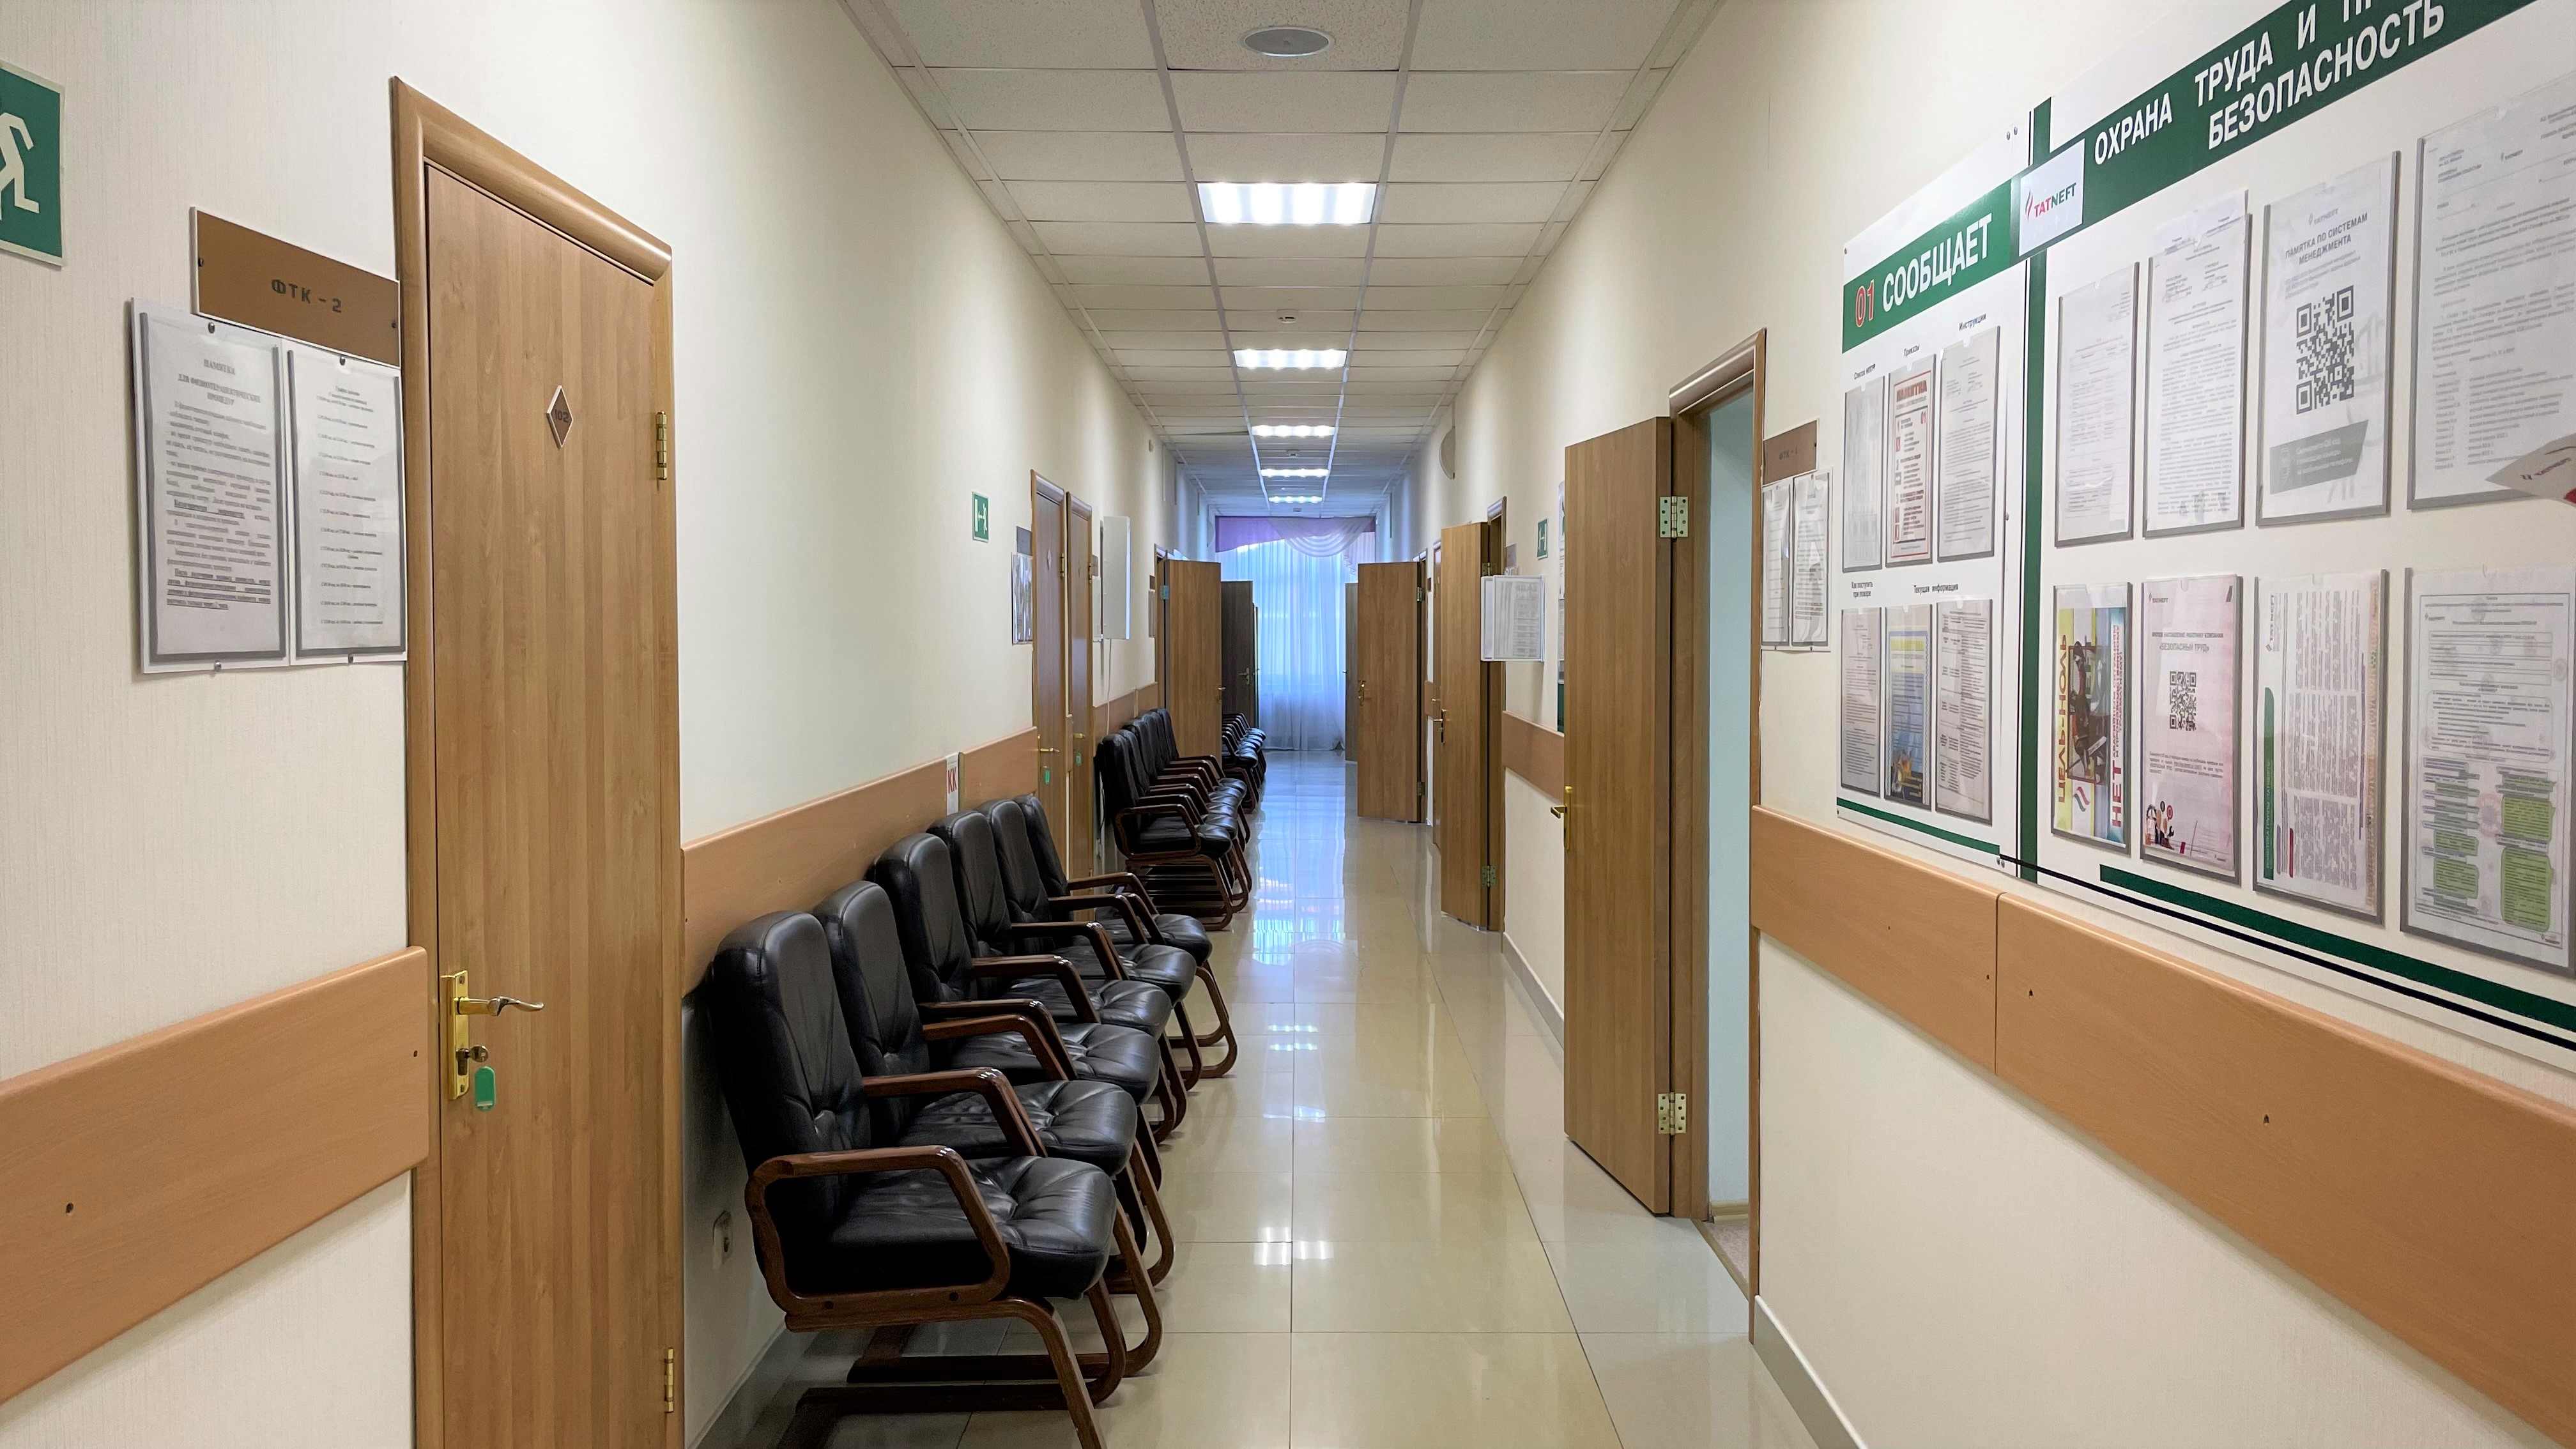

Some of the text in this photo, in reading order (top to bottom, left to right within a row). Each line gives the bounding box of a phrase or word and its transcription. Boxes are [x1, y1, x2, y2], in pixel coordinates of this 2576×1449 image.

[2094, 3, 2315, 165] ОХРАНА ТРУДА И
[2208, 0, 2444, 150] БЕЗОПАСНОСТЬ
[2034, 182, 2076, 217] TATNEFT
[2285, 212, 2368, 259] ПАМЯТКА ПО СИСТЕМАМ
[2299, 234, 2352, 265] МЕНЕДЖМЕНТА
[272, 279, 311, 304] ФТК
[1855, 213, 1992, 328] 01 СООБЩАЕТ
[555, 408, 569, 423] 102
[2058, 634, 2067, 803] ЦЕЛЬ-НОЛЬ
[2112, 760, 2122, 827] НЕТ
